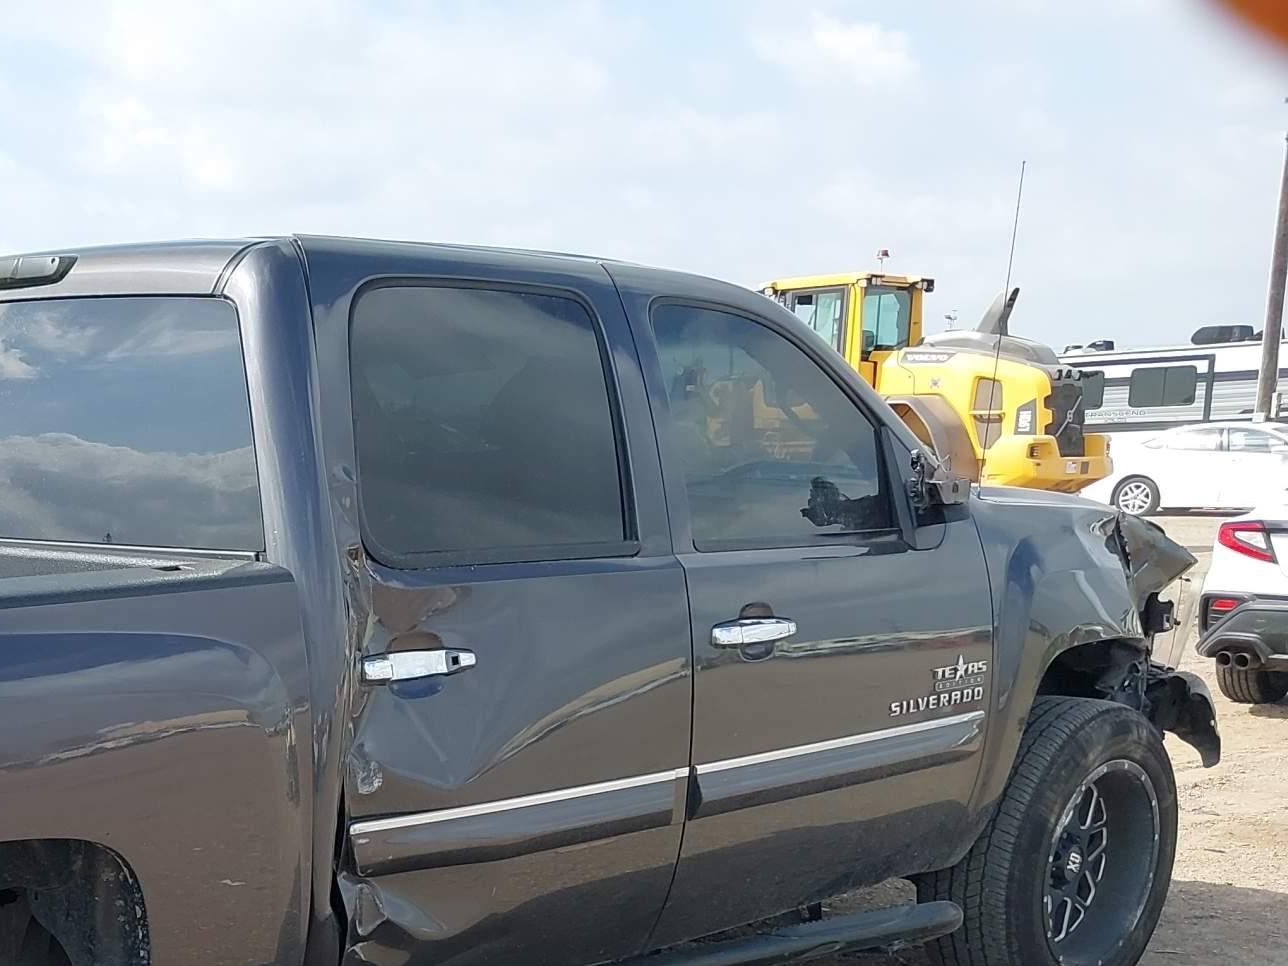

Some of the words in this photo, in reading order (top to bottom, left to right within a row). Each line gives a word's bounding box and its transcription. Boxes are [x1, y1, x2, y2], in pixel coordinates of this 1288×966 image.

[906, 353, 949, 362] VOLVO
[933, 654, 987, 681] TEXAS
[889, 686, 984, 717] SILVERADO
